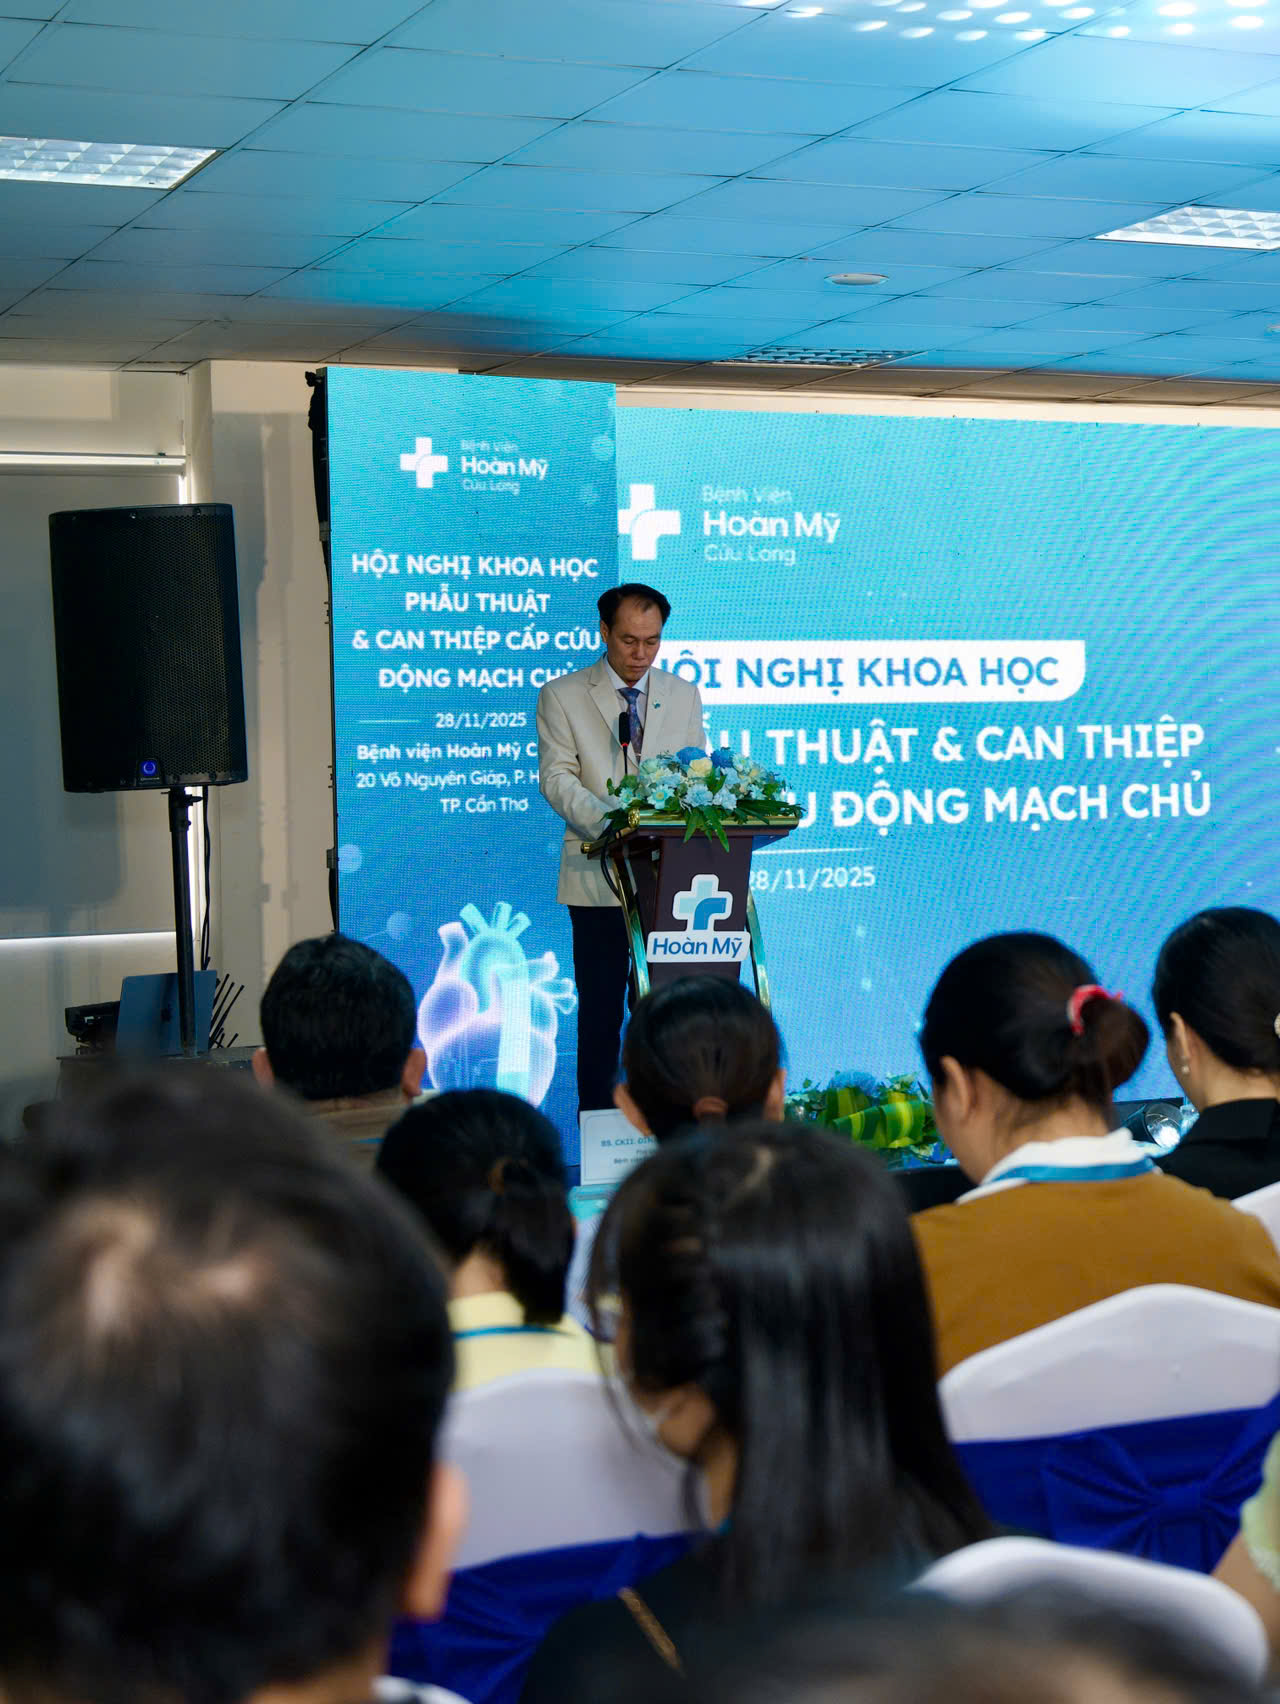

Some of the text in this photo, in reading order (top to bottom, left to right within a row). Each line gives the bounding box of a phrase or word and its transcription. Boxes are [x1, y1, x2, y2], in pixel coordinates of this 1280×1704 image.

[461, 455, 549, 481] Hoàn Mỹ
[702, 485, 748, 505] Bệnh
[703, 510, 841, 544] Hoàn Mỹ
[352, 548, 599, 582] HỘI NGHỊ KHOA HỌC
[748, 544, 796, 567] Long
[405, 584, 551, 618] PHẪU THUẬT
[352, 622, 600, 655] & CAN THIỆP CẤP CỨU
[378, 661, 578, 693] ĐỘNG MẠCH CH
[736, 658, 843, 696] NGHỊ
[857, 656, 968, 687] KHOA
[980, 656, 1059, 694] HỌC
[436, 711, 527, 730] 28/11/2025
[357, 743, 401, 764] Bệnh
[405, 743, 442, 762] viện
[447, 743, 492, 758] Hoàn
[497, 741, 522, 761] Mỹ
[765, 718, 919, 775] THUẬT
[932, 726, 965, 762] &
[976, 725, 1064, 762] CAN
[1076, 714, 1205, 769] THIỆP
[356, 772, 376, 788] 20
[379, 771, 401, 787] Võ
[405, 771, 467, 791] Nguyên
[470, 770, 511, 788] Giáp,
[514, 769, 526, 784] P.
[440, 798, 462, 813] TP.
[499, 797, 529, 812] Thơ
[831, 780, 969, 837] ĐỘNG
[984, 784, 1108, 832] MẠCH
[1122, 770, 1211, 819] CHỦ
[653, 937, 742, 958] Hoàn Mỹ
